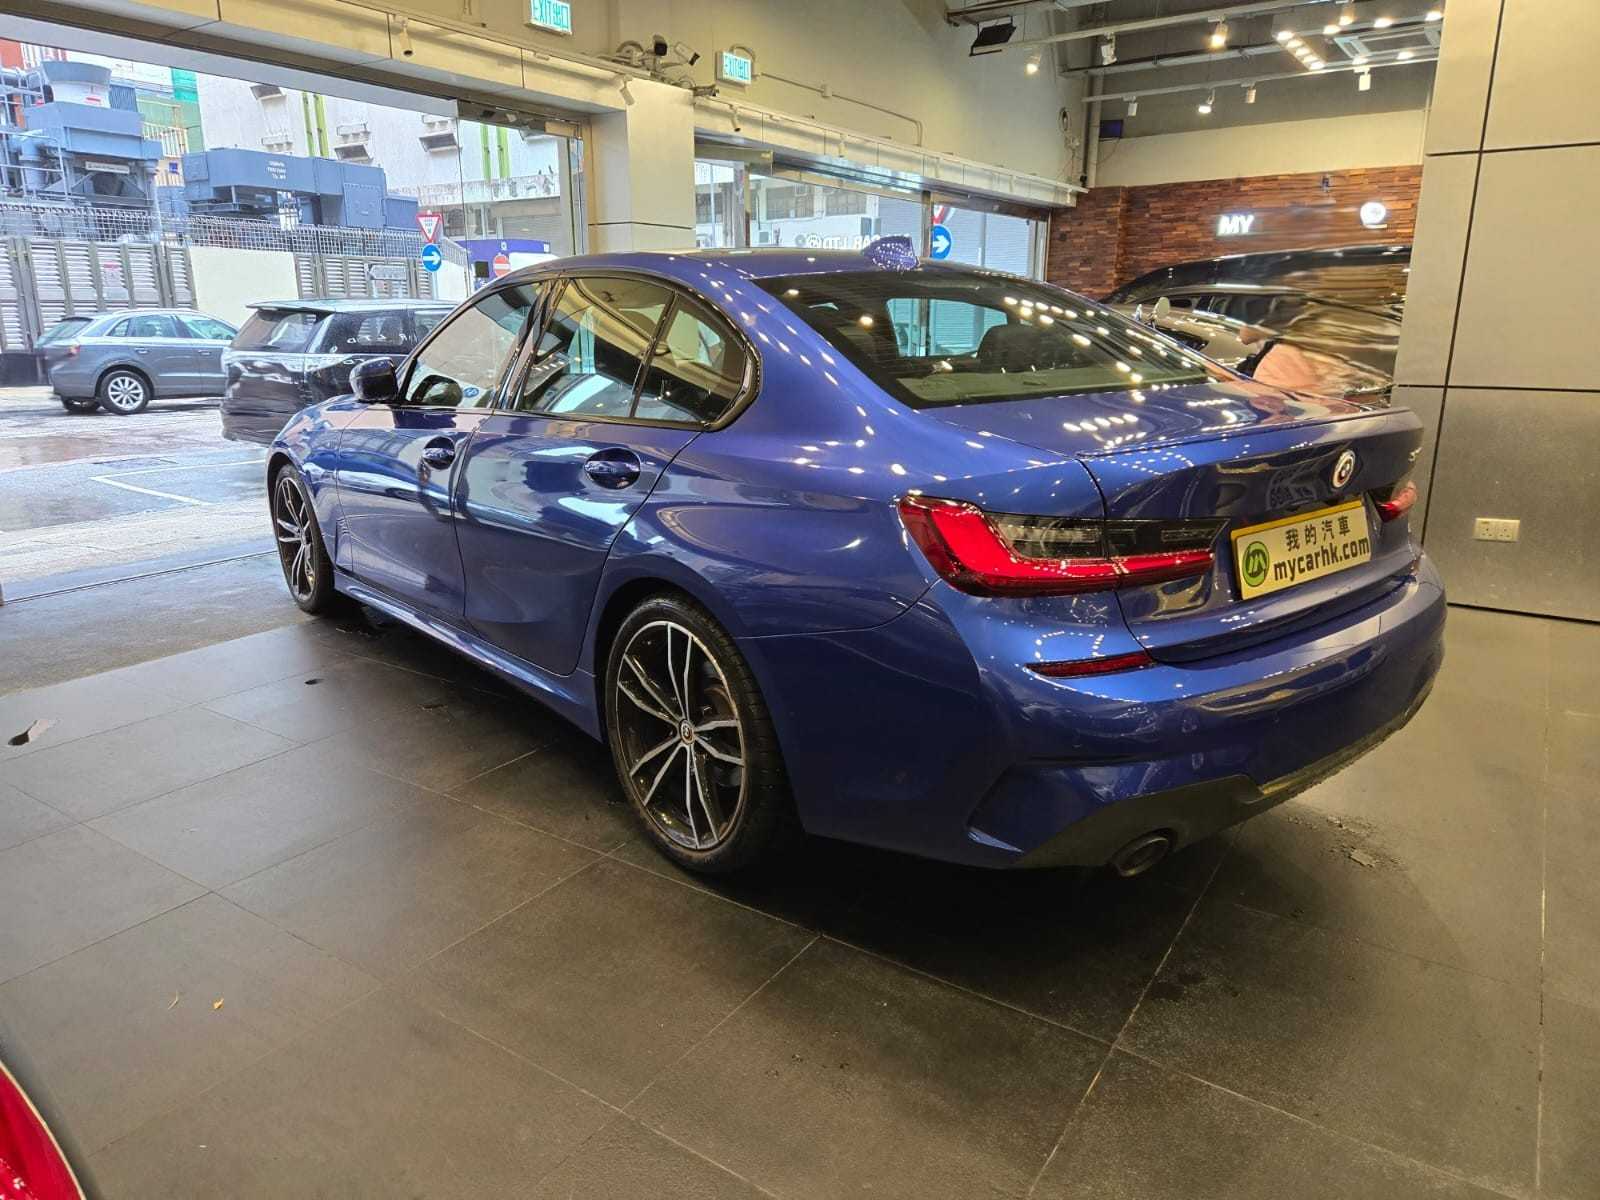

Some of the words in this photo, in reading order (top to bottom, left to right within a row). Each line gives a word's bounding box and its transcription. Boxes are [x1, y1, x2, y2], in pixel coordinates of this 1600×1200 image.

[532, 0, 552, 25] EXIT
[724, 54, 738, 77] EXIT
[1217, 213, 1255, 237] MY
[1285, 515, 1351, 552] 我的汽車
[1273, 536, 1370, 582] mycarhk.com
